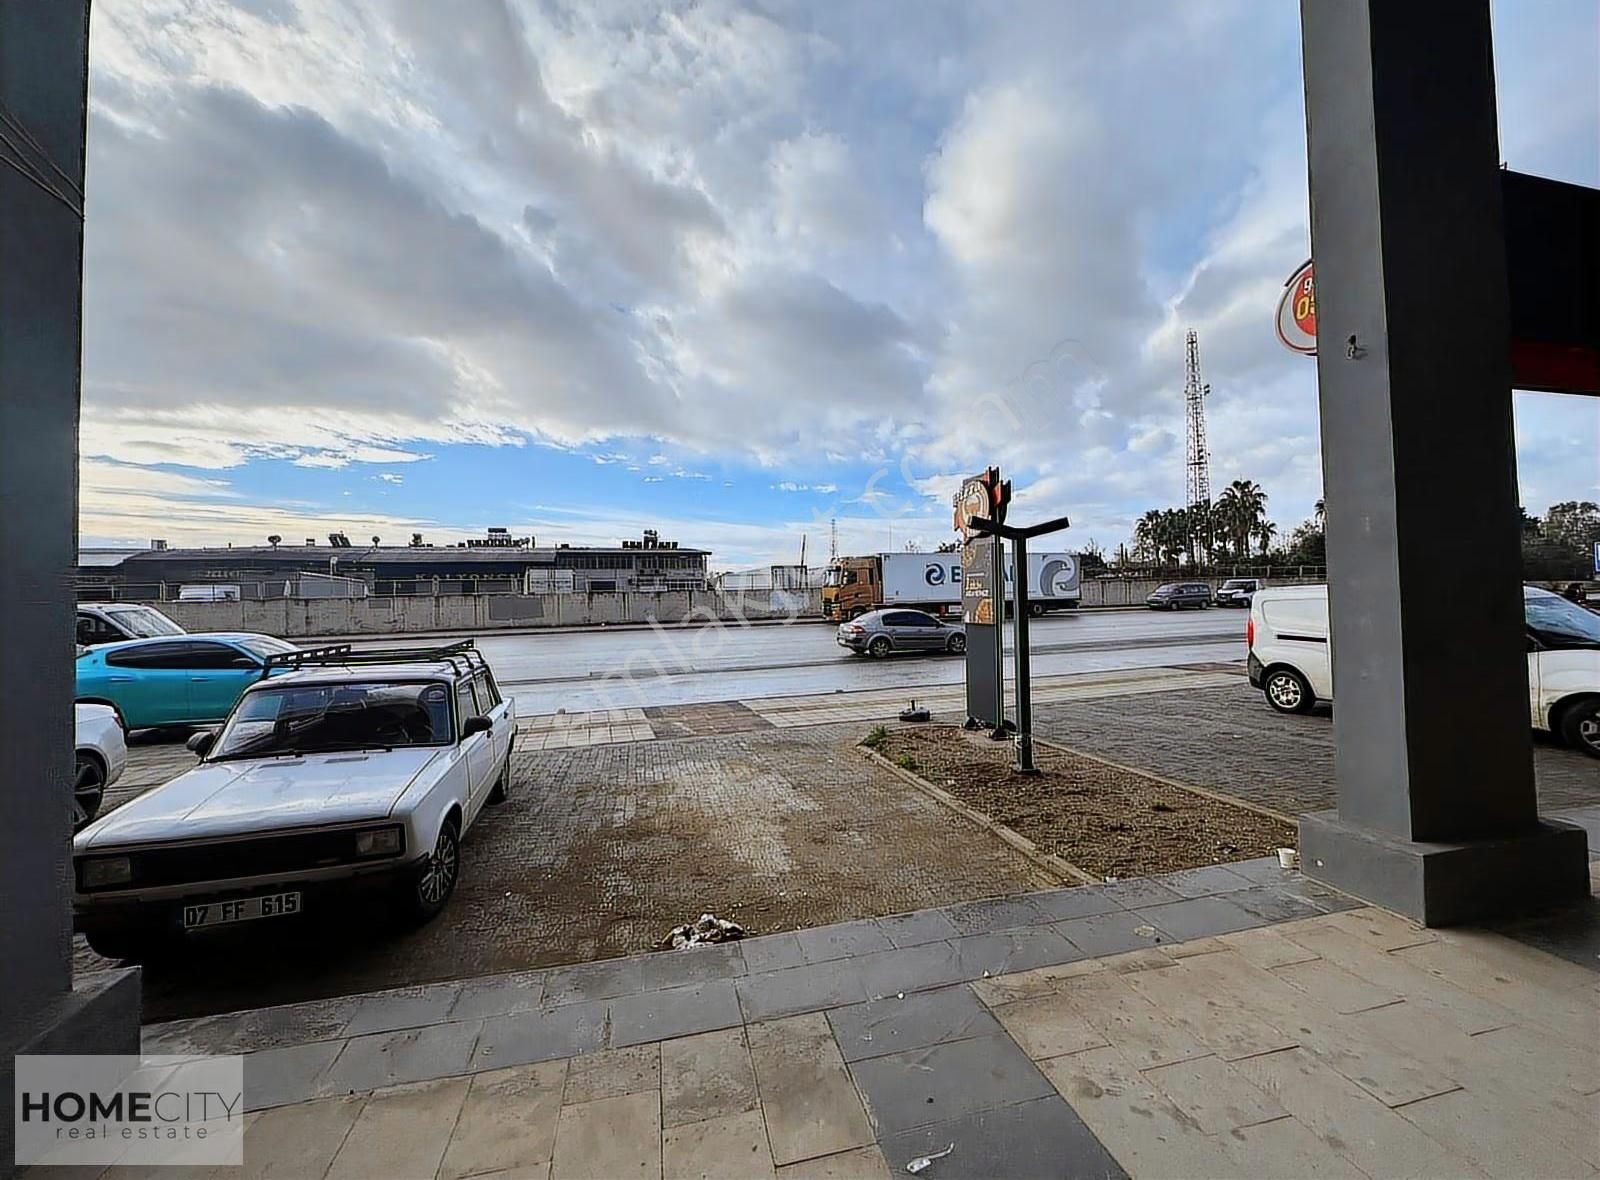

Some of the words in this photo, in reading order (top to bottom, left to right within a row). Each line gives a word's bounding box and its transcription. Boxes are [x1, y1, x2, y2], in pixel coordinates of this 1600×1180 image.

[186, 907, 208, 926] 07
[222, 902, 245, 921] FF
[262, 895, 297, 916] 615
